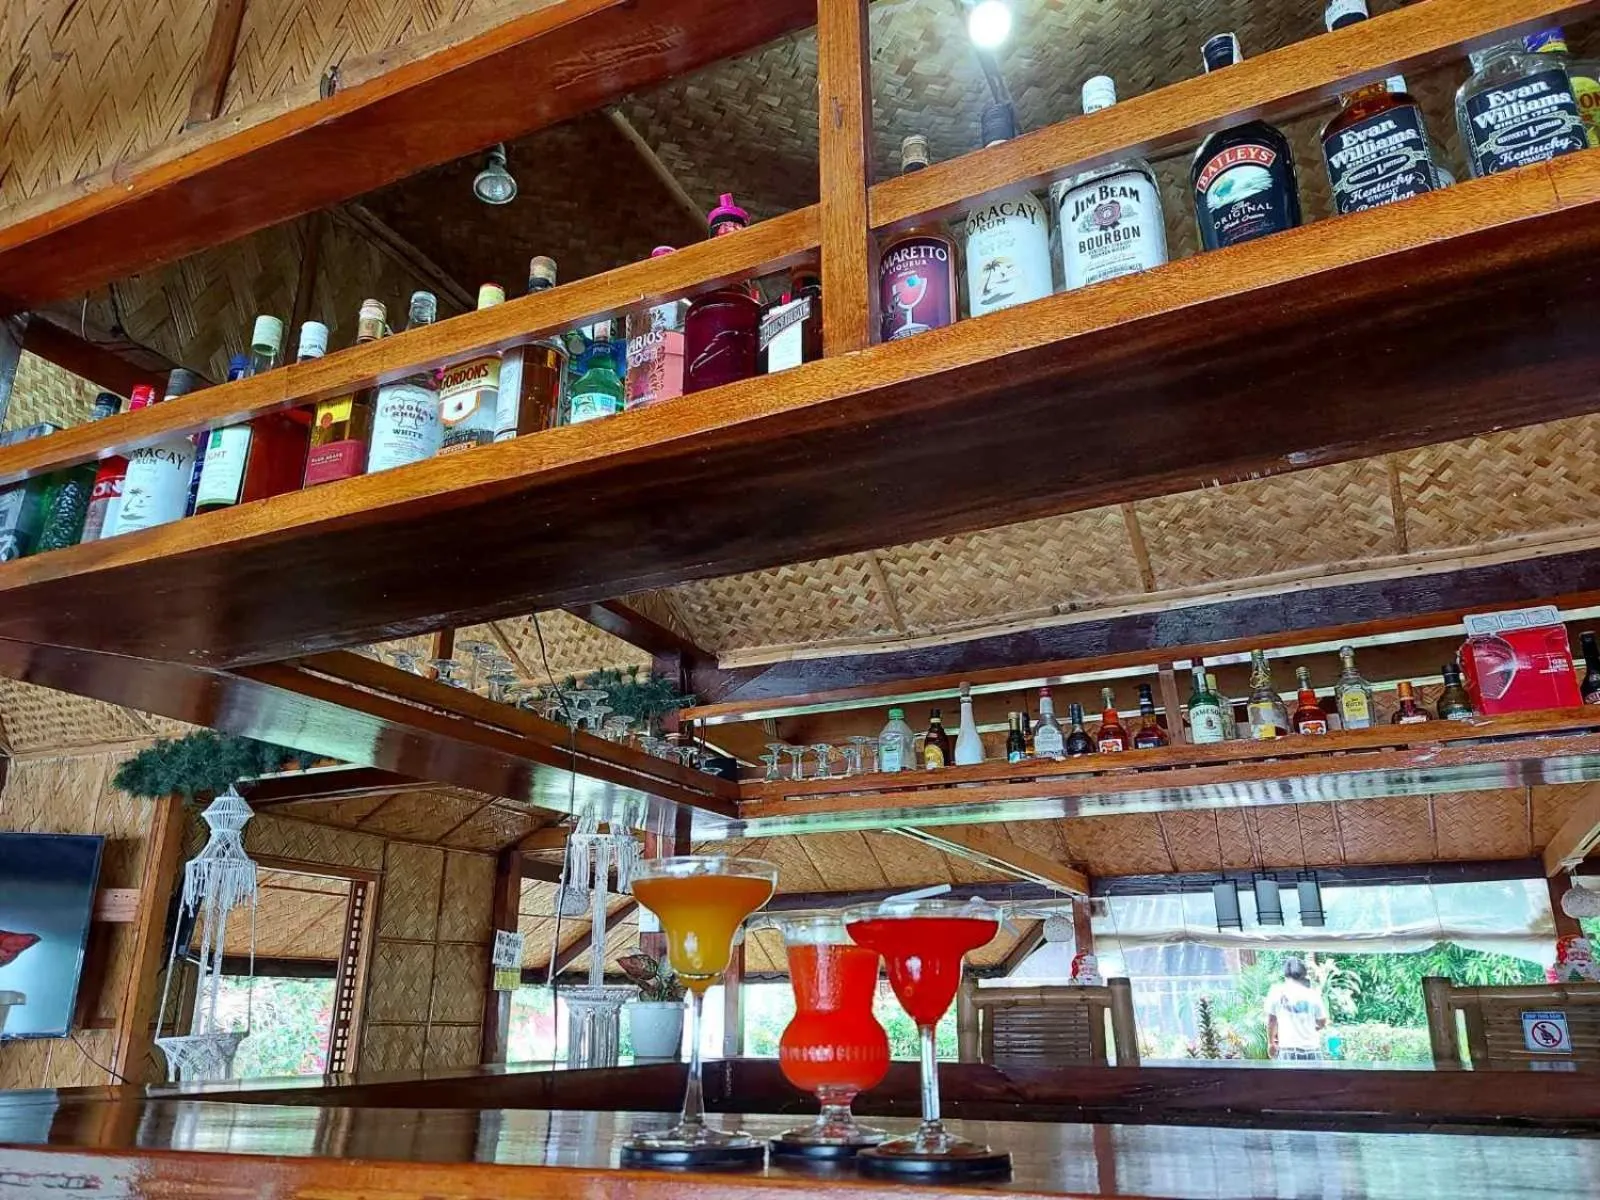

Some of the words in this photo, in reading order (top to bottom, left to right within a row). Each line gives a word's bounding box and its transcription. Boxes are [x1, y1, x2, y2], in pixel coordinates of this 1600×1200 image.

[1486, 81, 1551, 109] Evan
[1473, 92, 1574, 129] Williams
[1328, 128, 1420, 169] Williams
[1340, 119, 1397, 149] Evan
[1499, 136, 1573, 165] Kentucky
[1199, 146, 1274, 188] BAILEYS
[1349, 172, 1416, 204] Kentucky
[1071, 193, 1097, 223] JIM
[1098, 184, 1141, 204] BEAM
[1214, 202, 1273, 230] ORIGINAL
[979, 217, 1006, 233] RUM
[1078, 224, 1141, 254] BOURBON
[392, 428, 424, 439] WHITE
